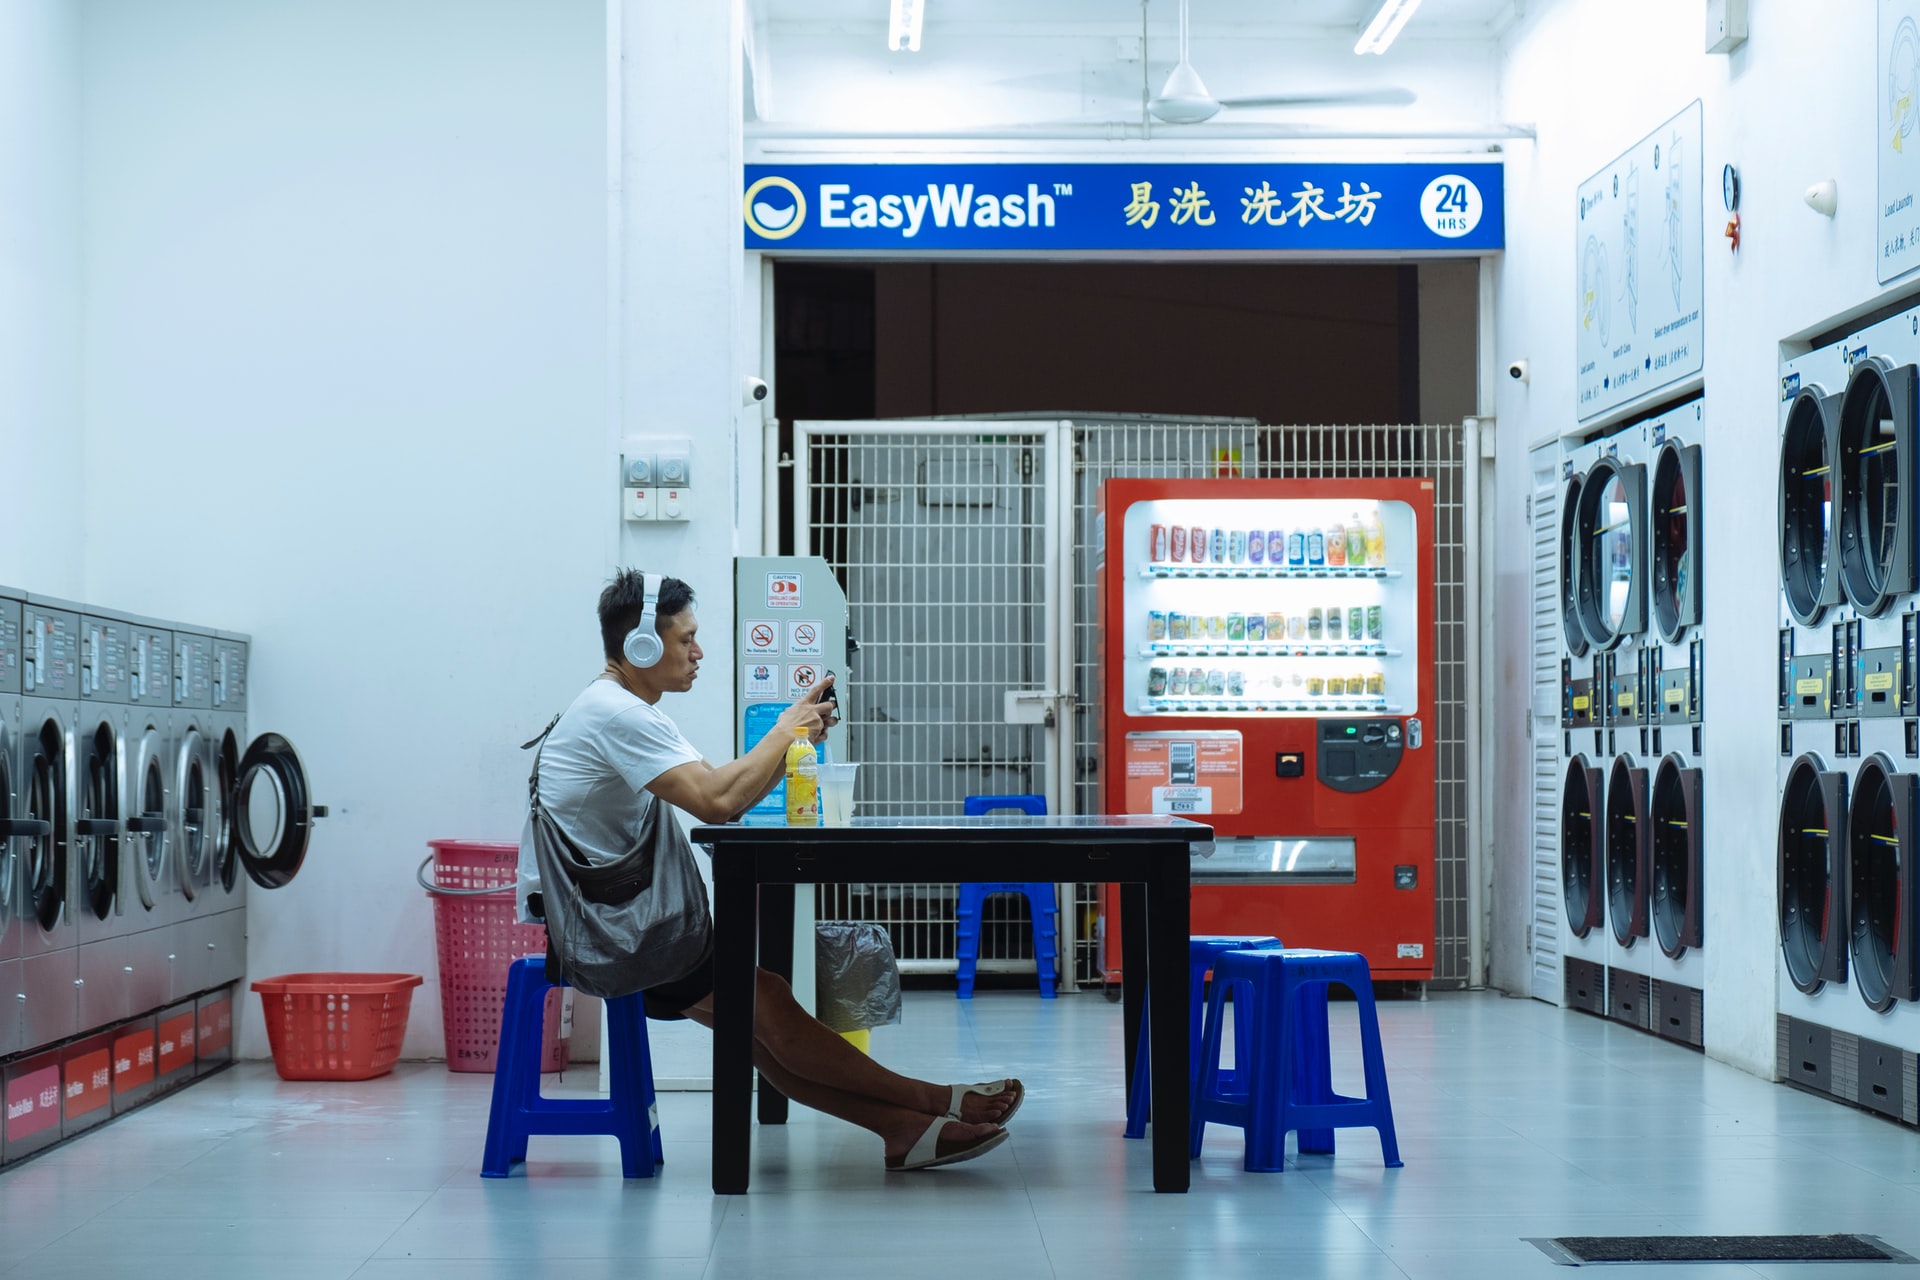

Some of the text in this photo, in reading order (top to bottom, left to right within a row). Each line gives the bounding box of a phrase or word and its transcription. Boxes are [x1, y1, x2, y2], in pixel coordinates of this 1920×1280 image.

[820, 184, 1055, 237] EasyWash
[1123, 181, 1382, 229] 易洗 洗衣坊
[1435, 184, 1468, 213] 24
[1438, 219, 1466, 230] HRS
